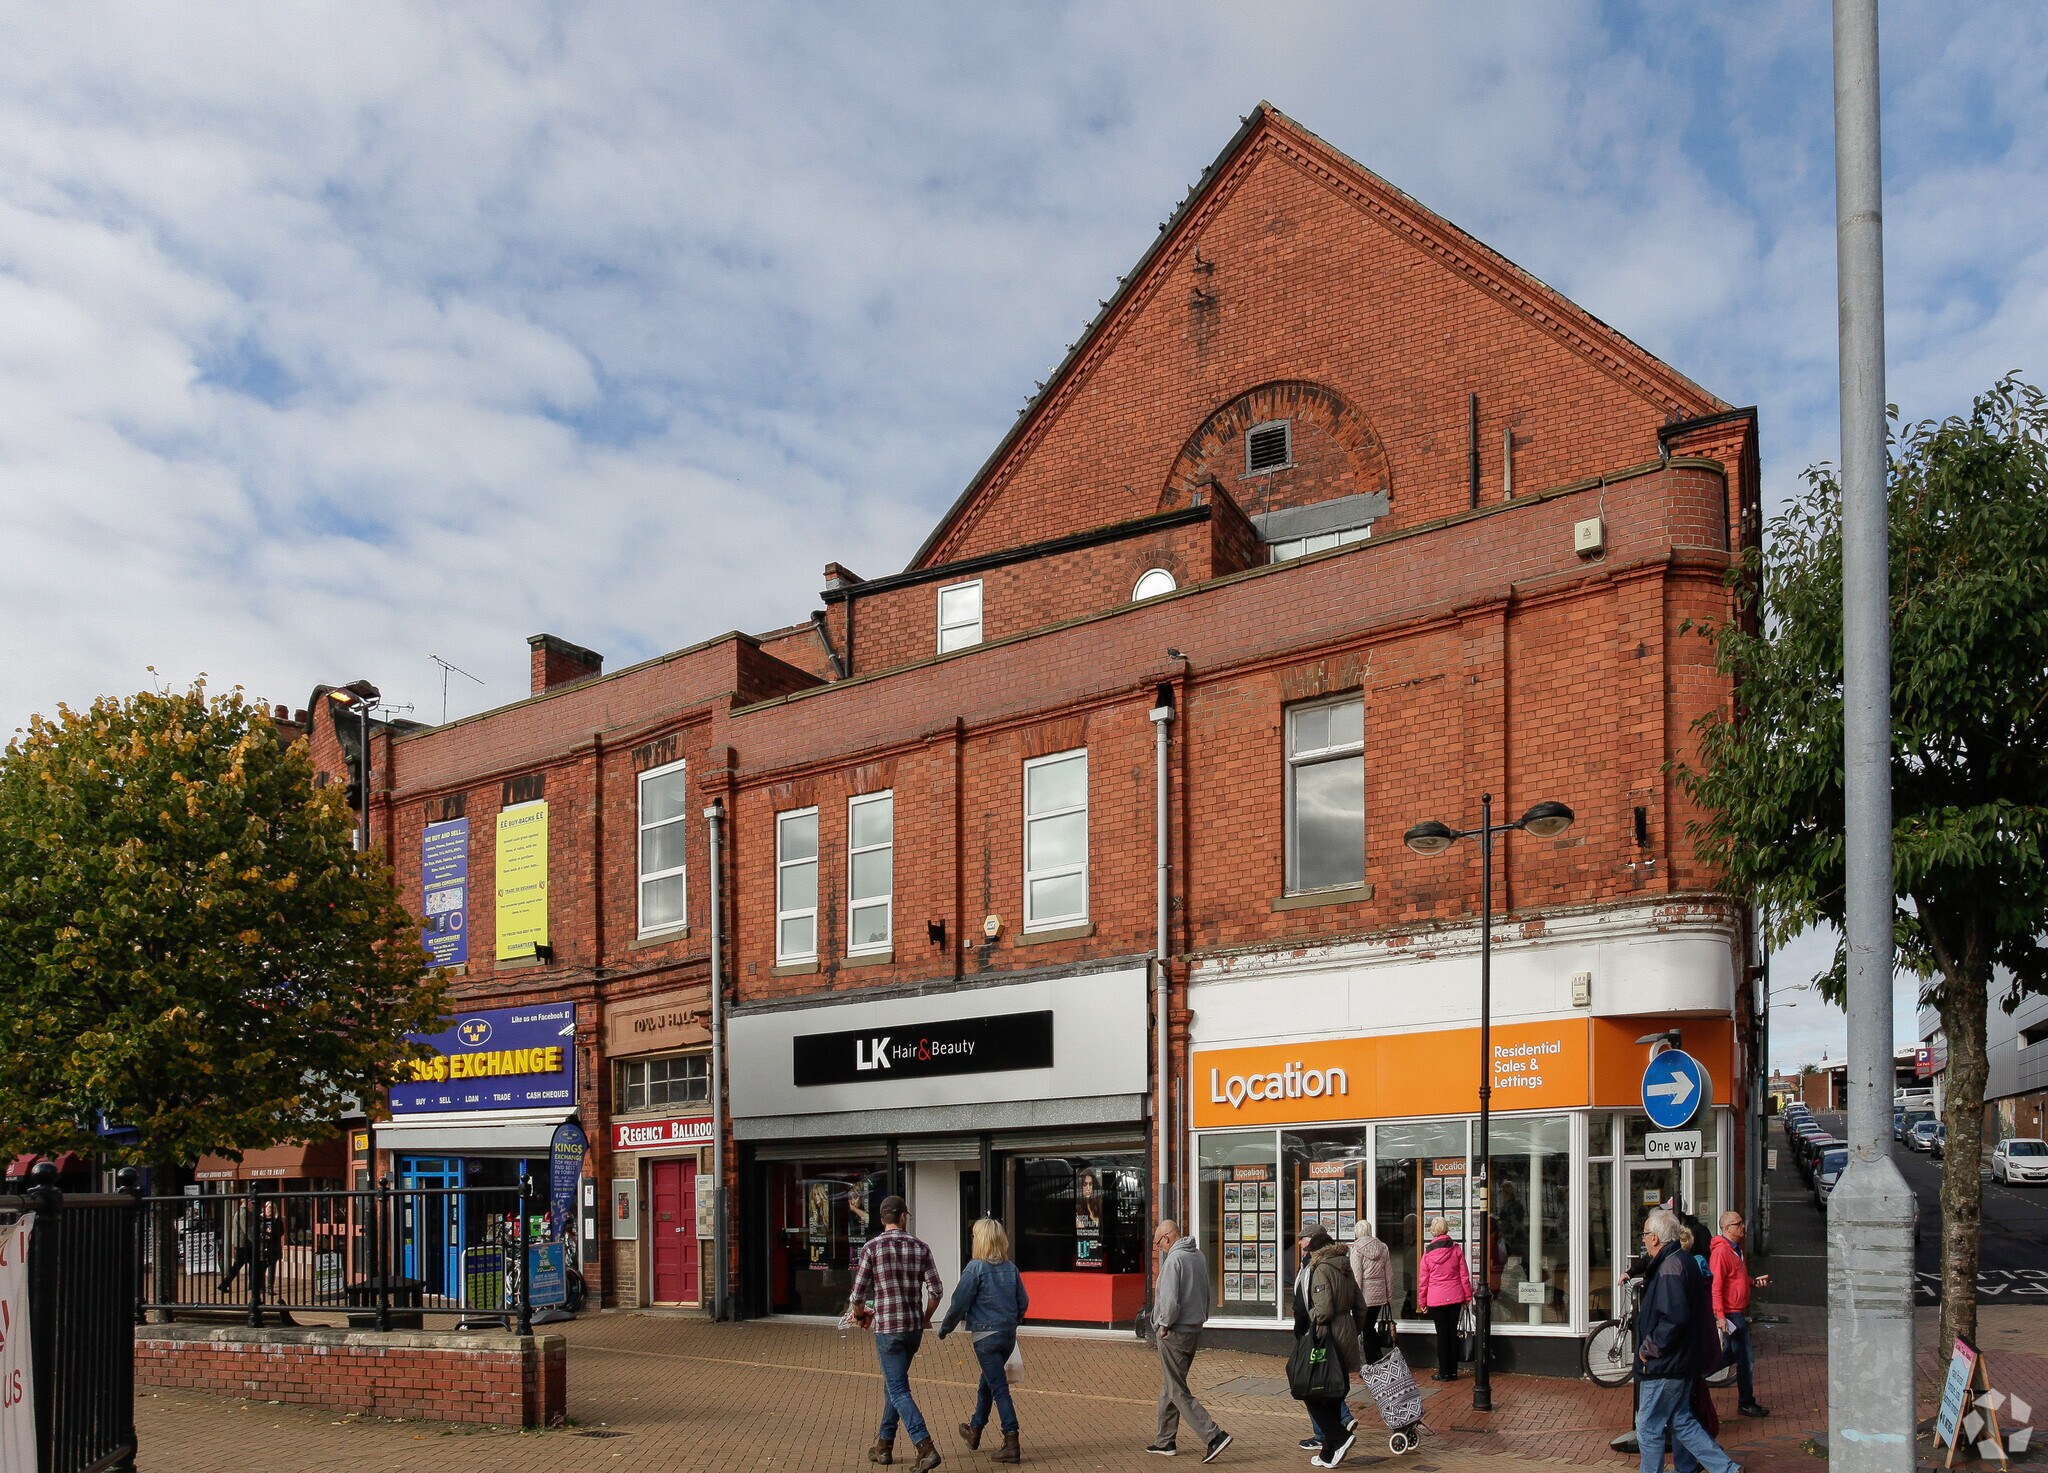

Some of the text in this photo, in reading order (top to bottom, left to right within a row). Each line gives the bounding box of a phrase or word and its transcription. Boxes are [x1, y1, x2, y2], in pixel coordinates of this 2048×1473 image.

[538, 1012, 563, 1020] Facebook
[634, 1010, 699, 1032] TOWN HALL
[856, 1037, 891, 1070] LK
[1494, 1040, 1561, 1058] Residential
[1919, 1051, 1928, 1062] P
[450, 1046, 562, 1079] EXCHANGE
[1494, 1058, 1539, 1073] Sales &
[1211, 1062, 1348, 1109] Location
[1494, 1074, 1543, 1088] Lettings
[542, 1090, 569, 1098] CHEQUES
[618, 1122, 714, 1146] REGENCY BALLROO
[1648, 1139, 1697, 1152] One way
[1235, 1168, 1264, 1177] Location
[1312, 1162, 1342, 1174] Location
[4, 1369, 22, 1408] us
